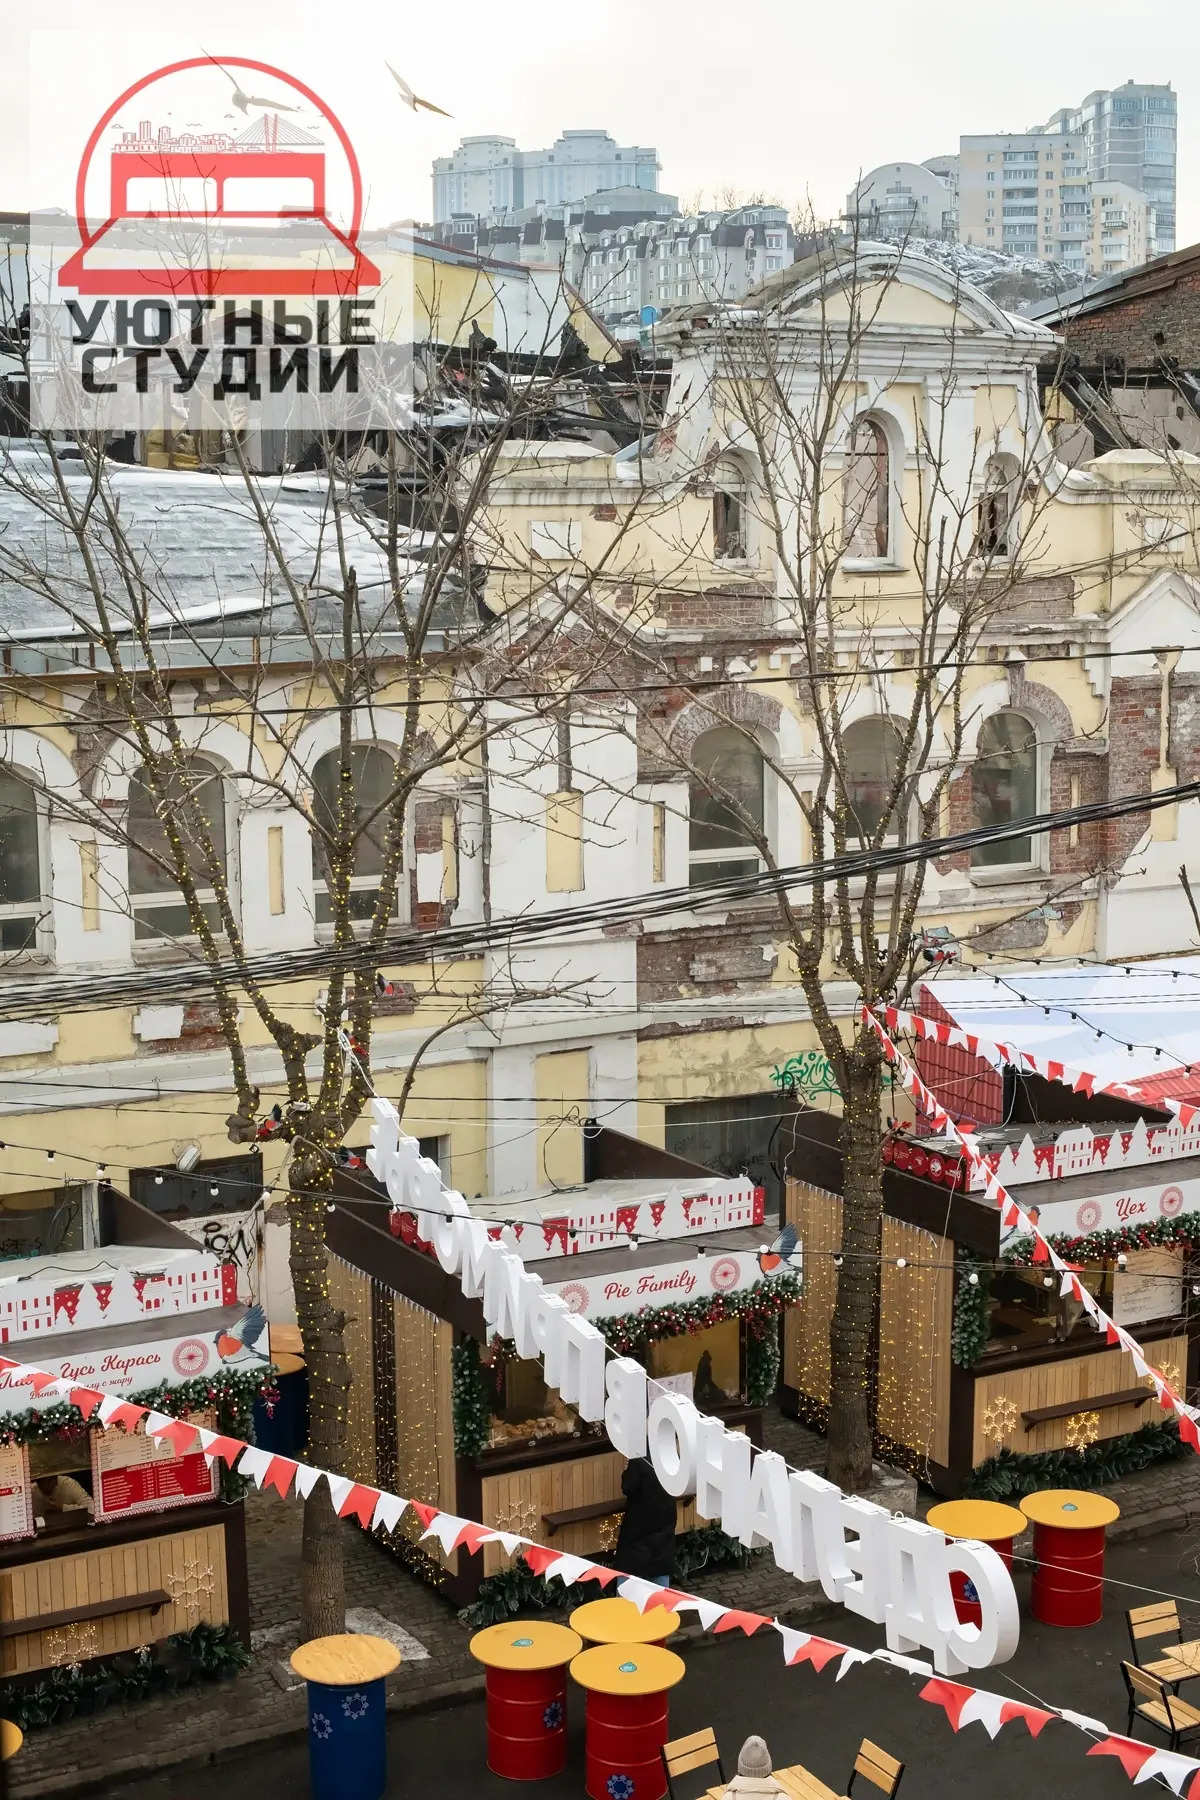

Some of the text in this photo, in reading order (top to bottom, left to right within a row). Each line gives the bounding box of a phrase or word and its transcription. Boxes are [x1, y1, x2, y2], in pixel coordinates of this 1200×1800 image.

[1116, 1196, 1148, 1222] Цех
[604, 1269, 698, 1300] Pie Family
[60, 1362, 96, 1381] Гусь
[100, 1354, 161, 1375] Карась
[109, 1376, 133, 1388] жару
